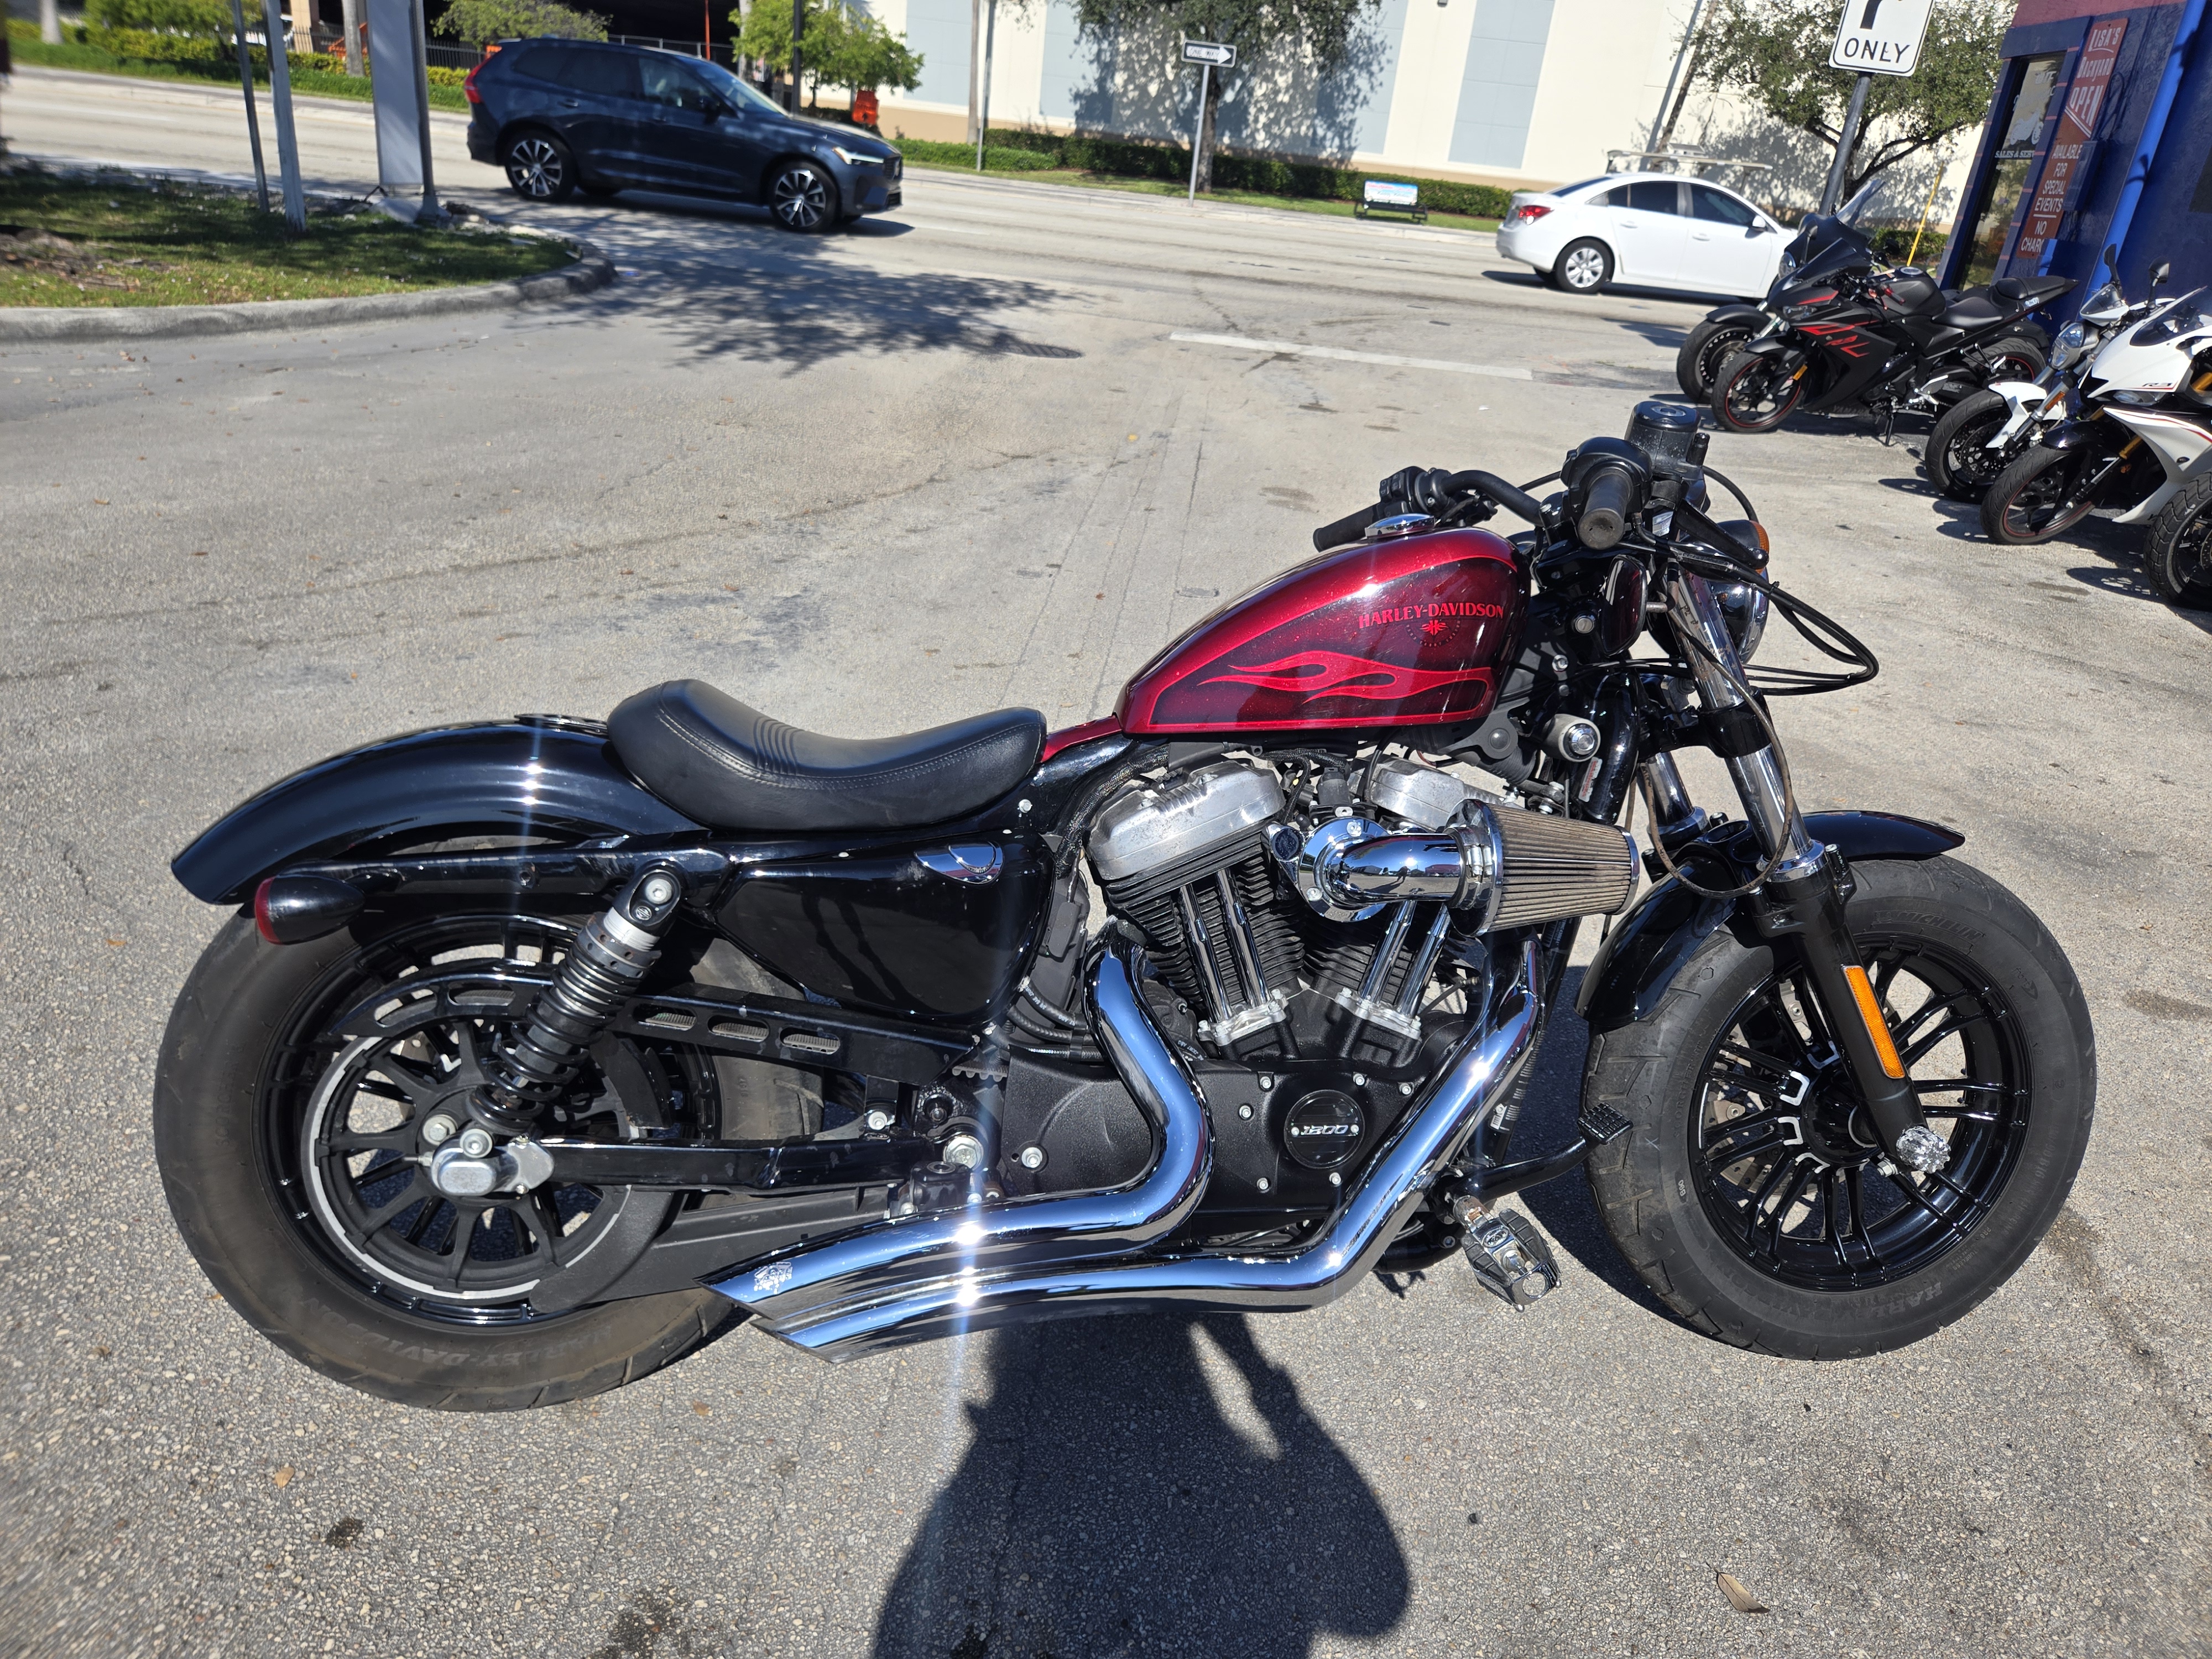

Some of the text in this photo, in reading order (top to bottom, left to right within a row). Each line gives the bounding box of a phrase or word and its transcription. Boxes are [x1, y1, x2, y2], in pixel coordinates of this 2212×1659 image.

[2088, 27, 2122, 52] LISA'S
[1844, 37, 1911, 64] ONLY
[2069, 85, 2104, 127] OPEN
[1995, 150, 2015, 159] SALES
[2052, 144, 2083, 159] AVAILABLE
[2053, 162, 2068, 178] FOR
[2042, 180, 2066, 195] SPECIAL
[2034, 197, 2063, 213] EVENTS
[2034, 221, 2047, 236] NO
[1359, 602, 1504, 629] HARLEY-DAVIDSON
[1897, 911, 1985, 941] MICHELIN
[1301, 1124, 1349, 1135] 1200
[1952, 1249, 1978, 1271] TUBELESS
